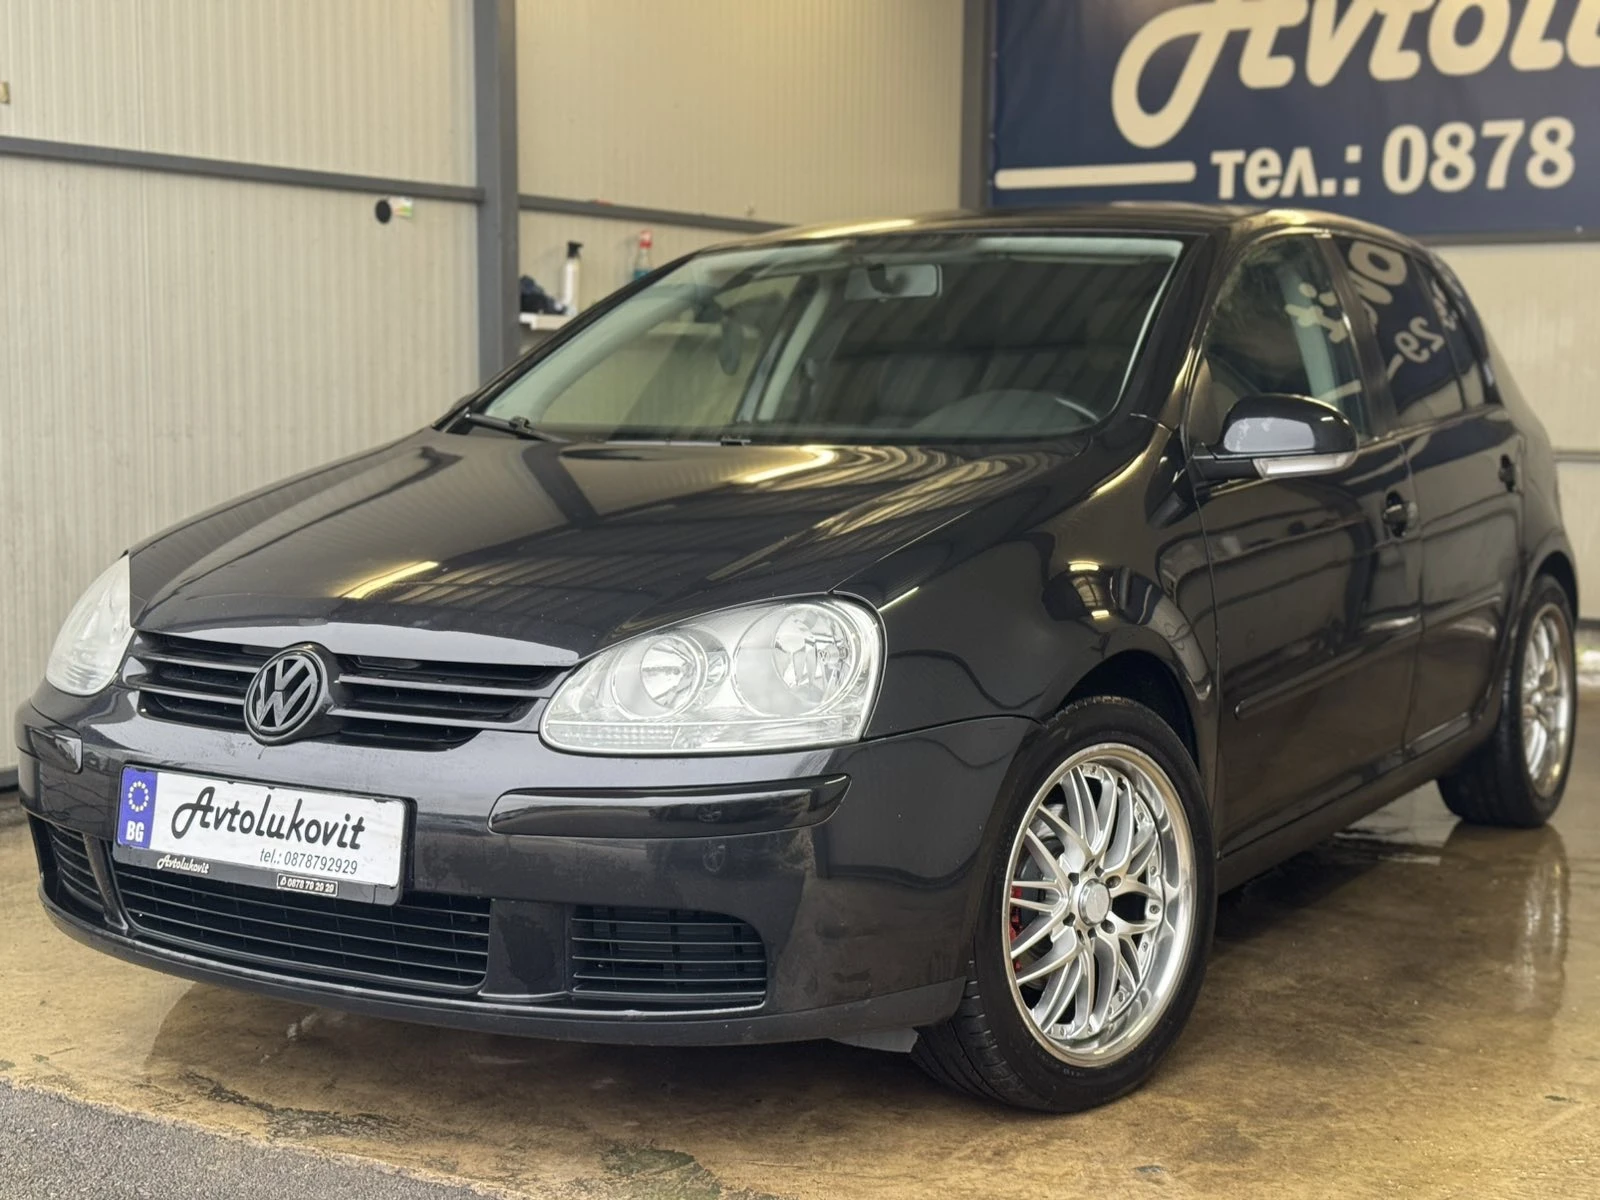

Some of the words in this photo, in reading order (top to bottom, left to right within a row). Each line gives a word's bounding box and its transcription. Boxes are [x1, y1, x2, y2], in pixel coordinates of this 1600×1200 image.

[1210, 145, 1363, 200] тел.:
[171, 786, 365, 849] Avtolukovit
[126, 821, 144, 842] BG
[157, 855, 209, 874] Avtolukovit
[260, 848, 282, 864] tel.:
[284, 851, 358, 875] 0878792929
